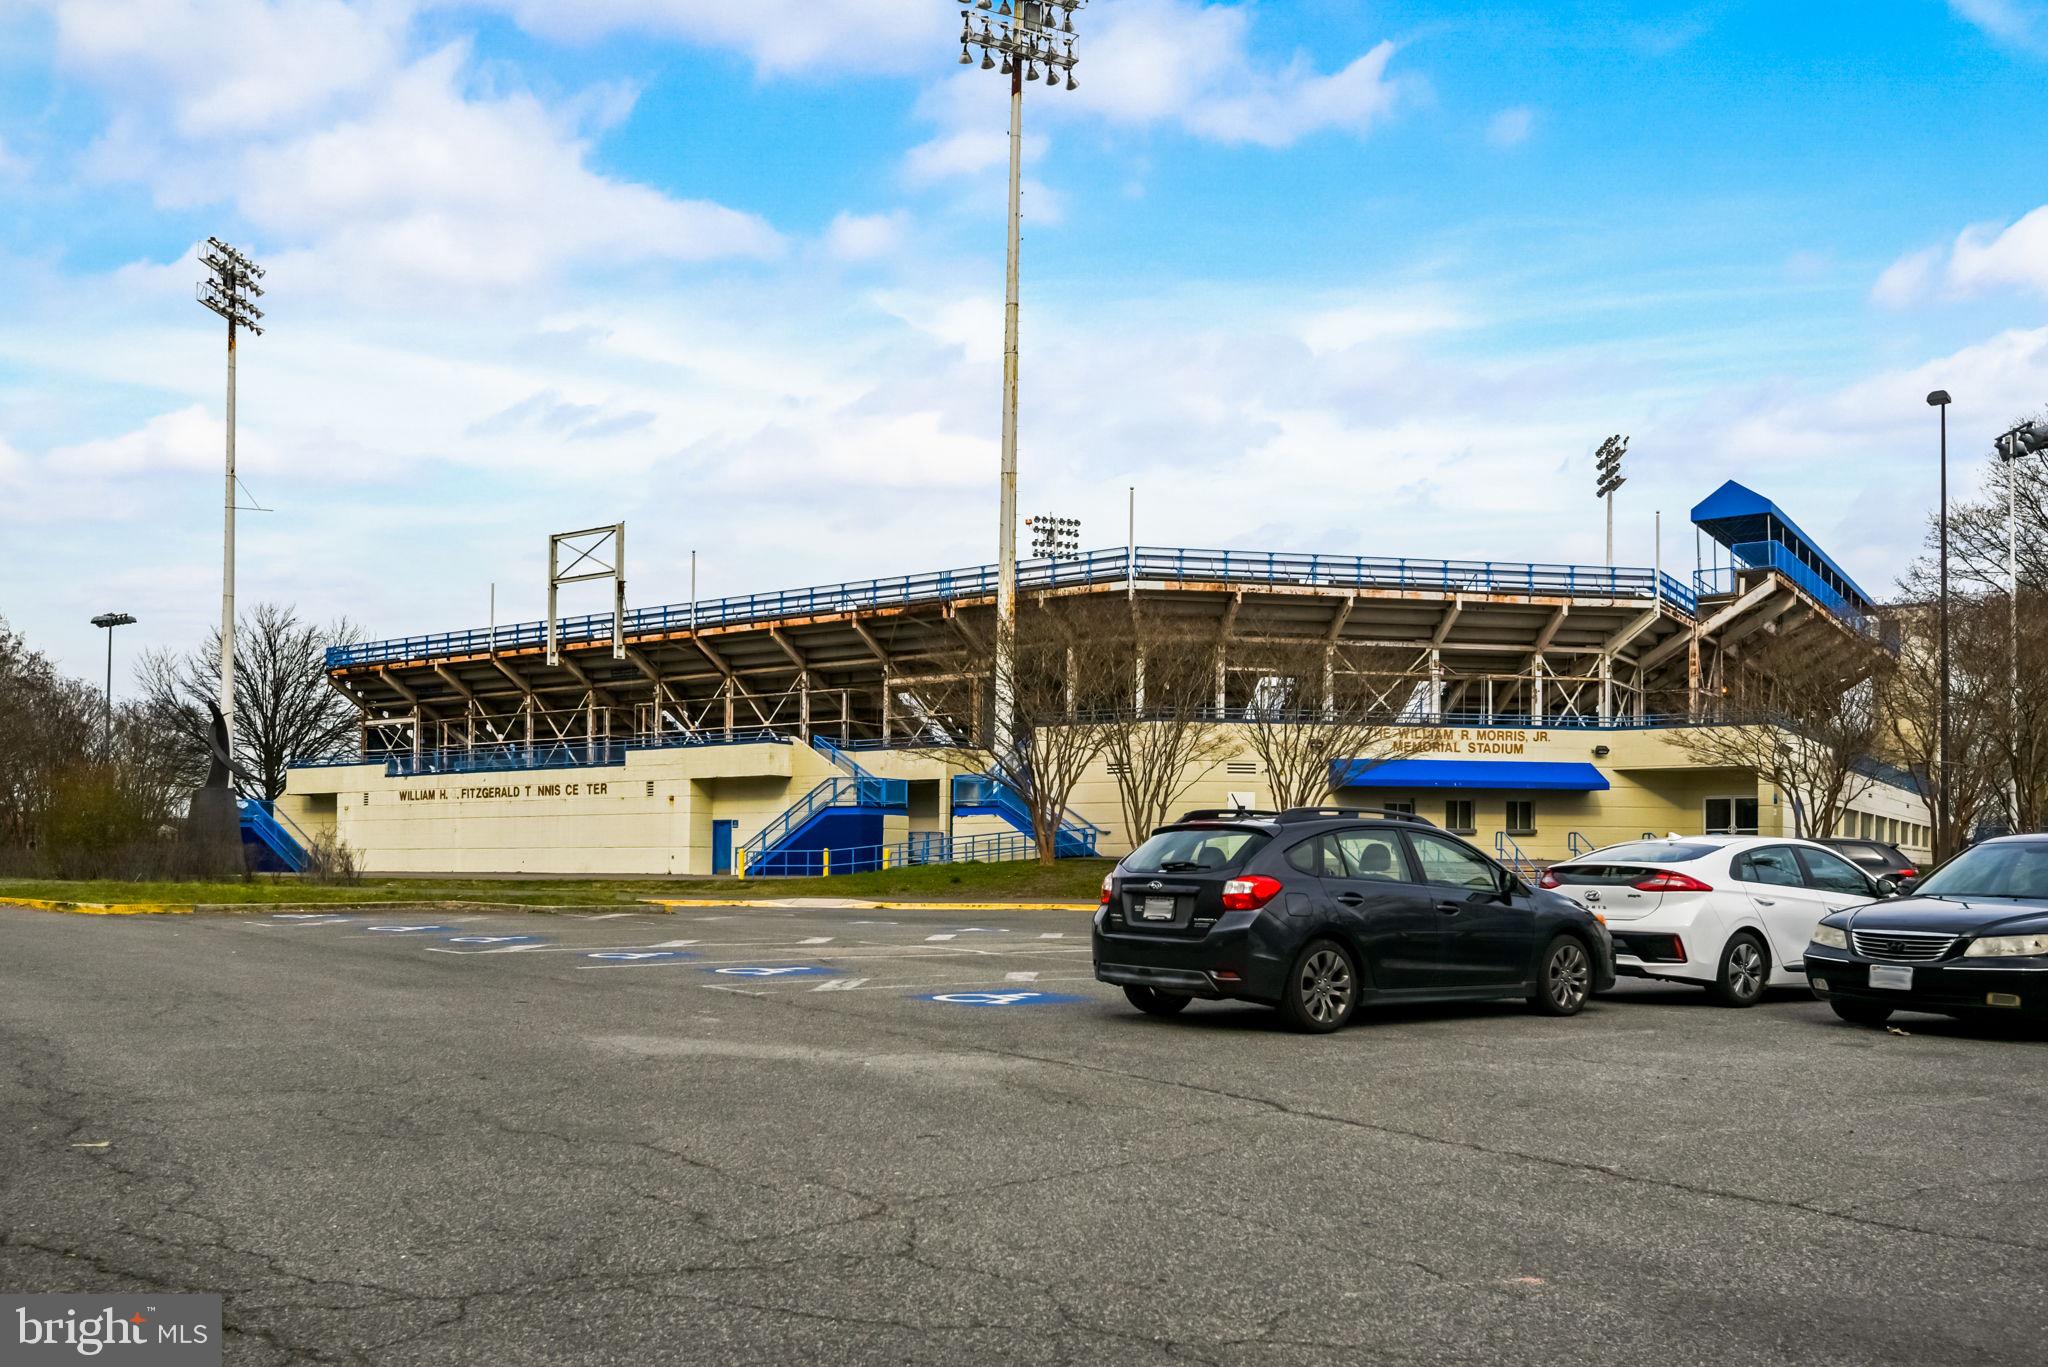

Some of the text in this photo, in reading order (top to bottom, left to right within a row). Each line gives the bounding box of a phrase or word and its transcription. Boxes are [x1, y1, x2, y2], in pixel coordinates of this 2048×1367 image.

[1399, 727, 1453, 740] WILLIAM
[1461, 729, 1472, 741] R.
[1476, 729, 1528, 743] MORRIS,
[1533, 731, 1551, 742] JR.
[1392, 741, 1524, 754] MEMORIAL STADIUM
[400, 789, 435, 801] WILLIAM
[440, 789, 448, 800] H.
